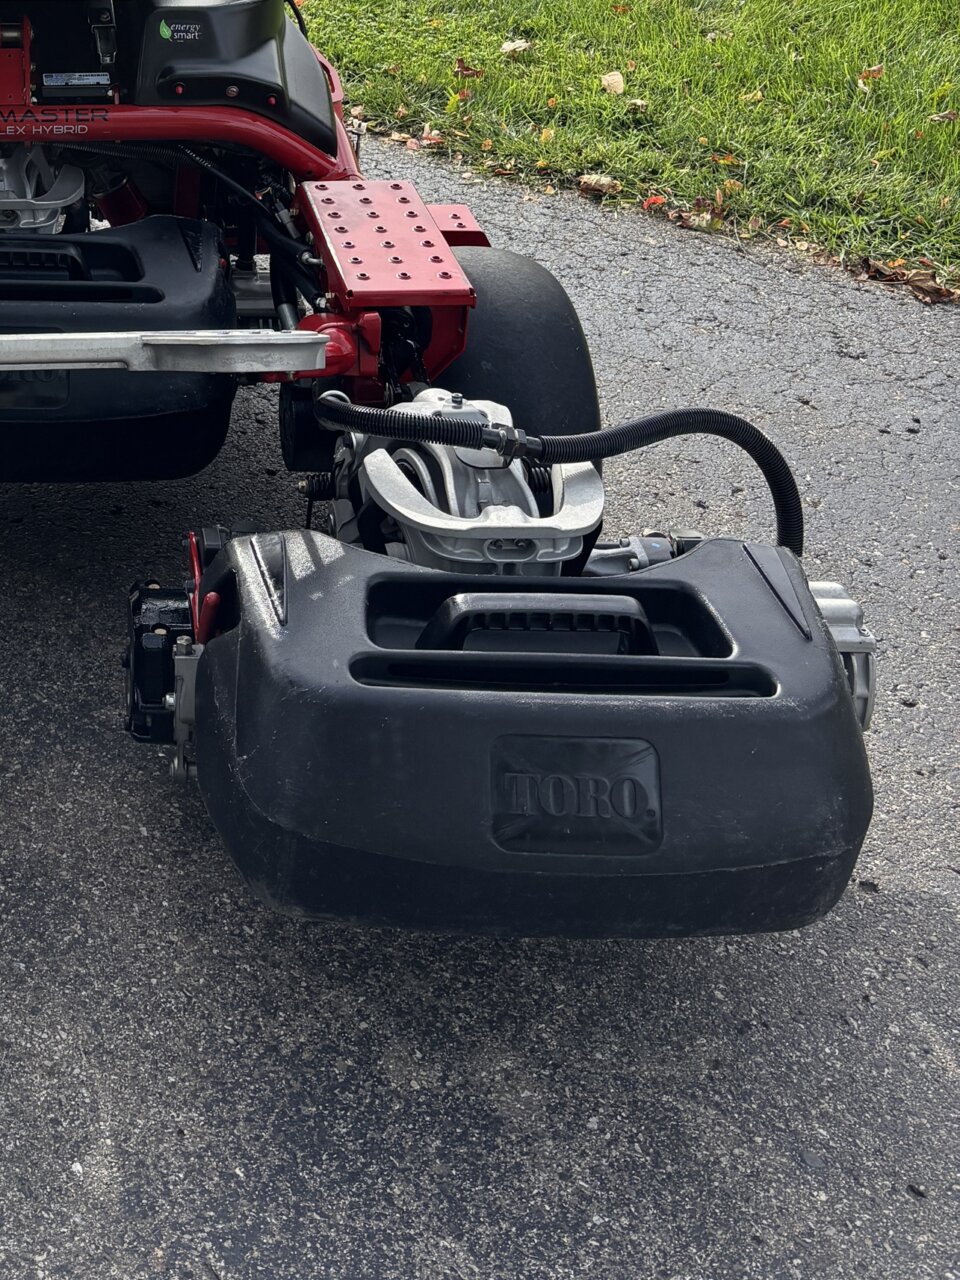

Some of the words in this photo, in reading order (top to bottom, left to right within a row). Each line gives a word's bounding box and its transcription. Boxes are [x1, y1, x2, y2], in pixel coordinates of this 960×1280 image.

[170, 23, 201, 33] energy
[173, 31, 199, 40] smart
[32, 125, 89, 135] HYBRID
